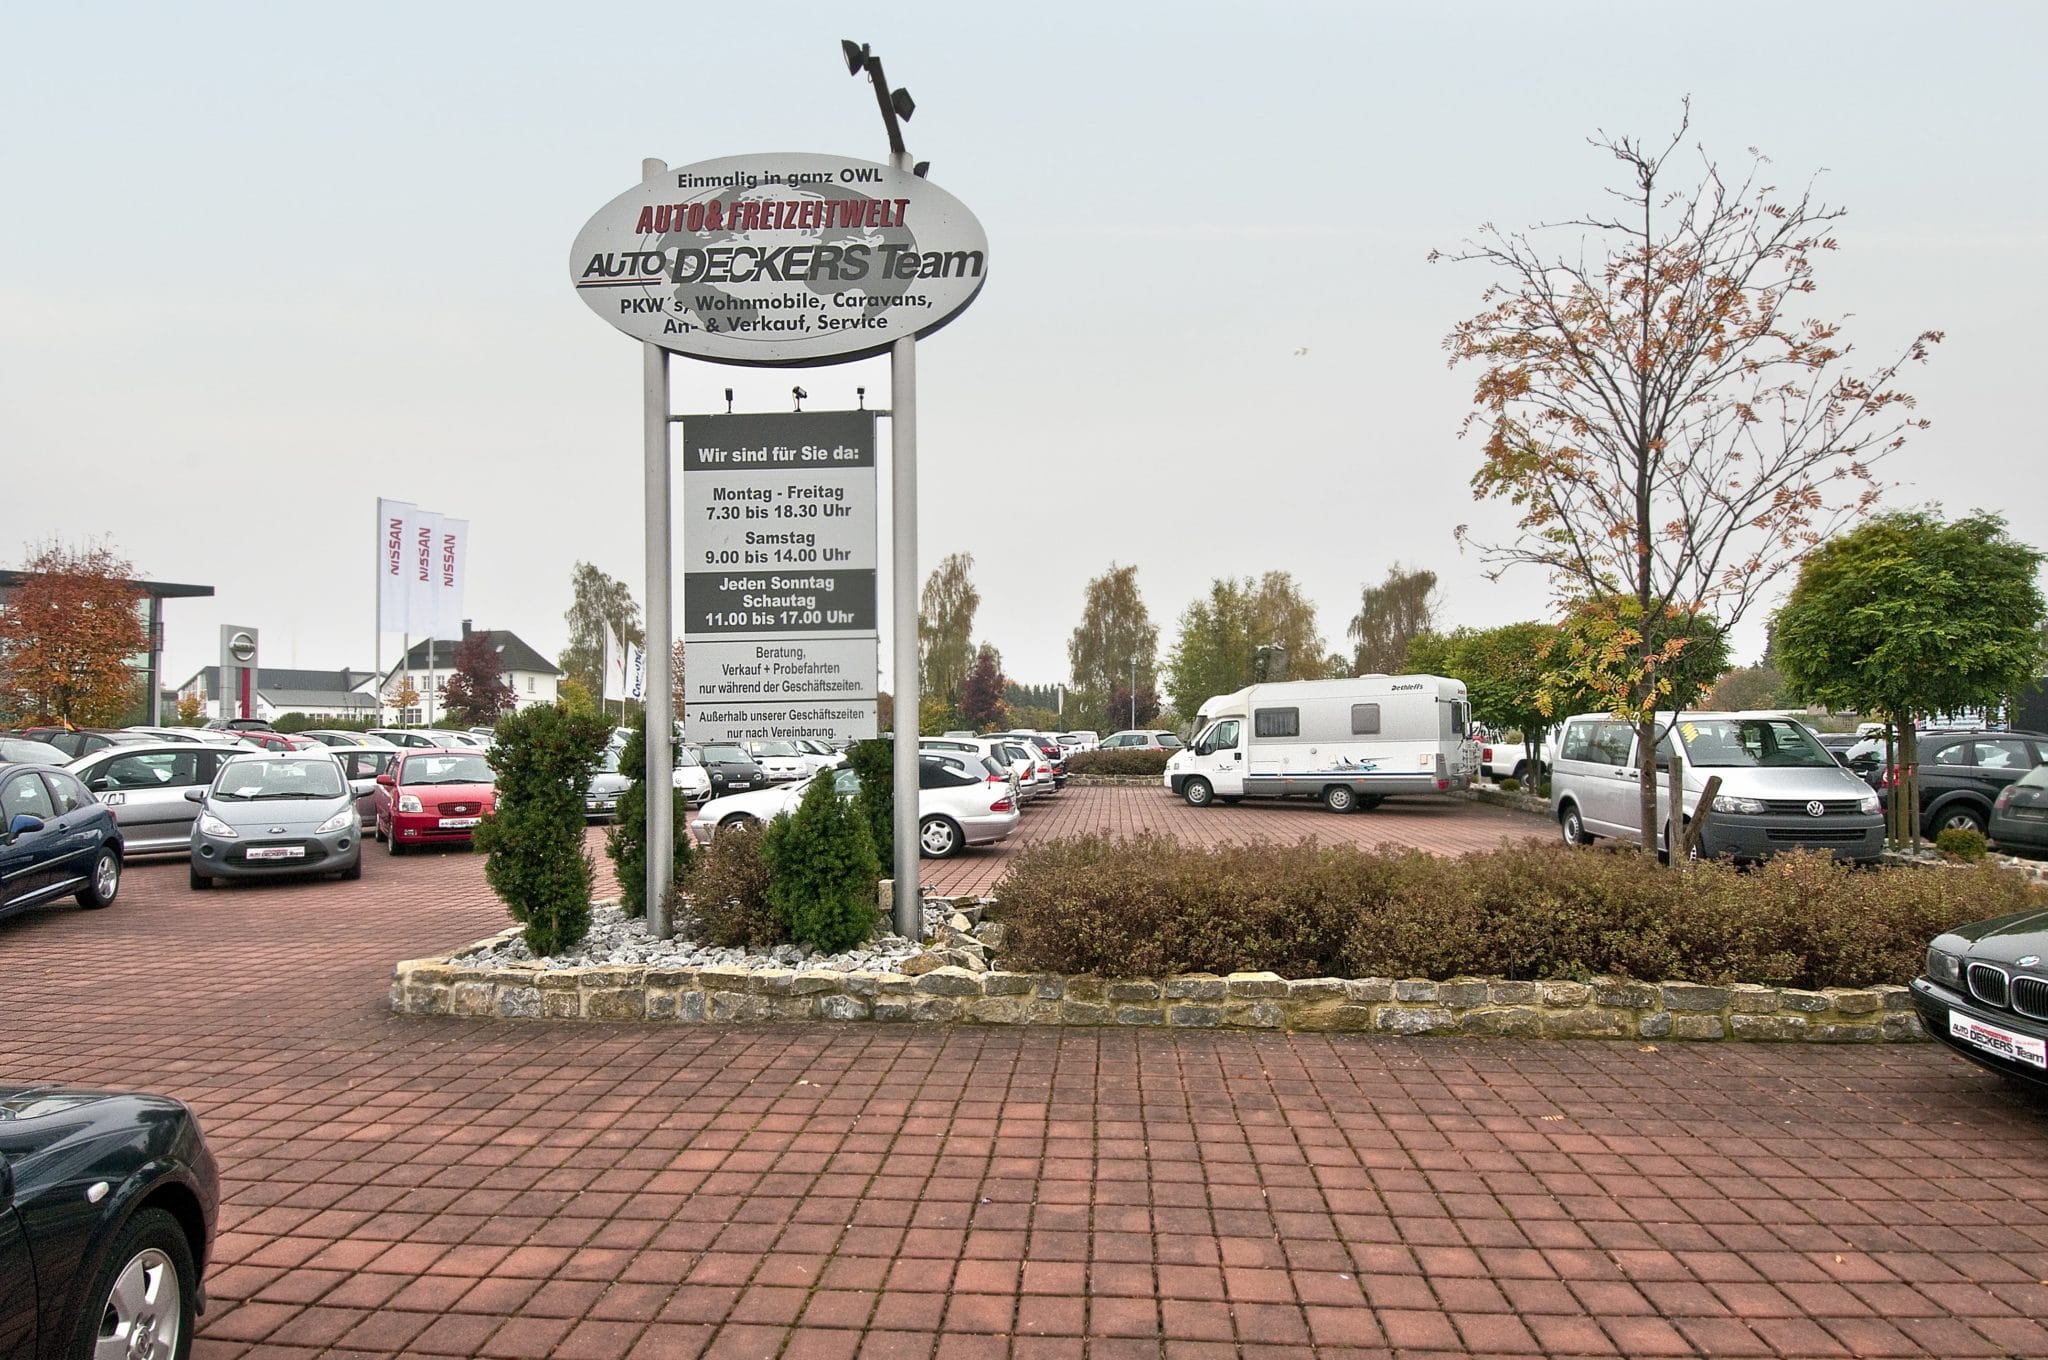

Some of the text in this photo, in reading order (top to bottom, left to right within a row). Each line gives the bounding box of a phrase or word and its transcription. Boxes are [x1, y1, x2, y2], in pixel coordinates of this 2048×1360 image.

[678, 169, 883, 190] Einmalig in ganz OWL
[583, 243, 984, 283] AUTO DECKERS Team
[695, 293, 826, 311] Wohnmobile,
[833, 292, 933, 309] Caravans,
[663, 315, 888, 334] An- & Verkauf, Service
[699, 446, 859, 463] Wir sind für Sie da:
[713, 487, 772, 502] Montag
[788, 486, 844, 501] Freitag
[706, 504, 851, 520] 7.30 bis 18.30 Uhr
[745, 531, 815, 546] Samstag
[389, 519, 402, 575] NISSAN
[418, 528, 431, 581] NISSAN
[443, 534, 455, 587] NISSAN
[705, 548, 851, 564] 9.00 bis 14.00 Uhr
[720, 576, 834, 591] Jeden Sonntag
[743, 594, 816, 608] Schautag
[705, 611, 854, 626] 11.00 bis 17.00 Uhr
[756, 646, 806, 660] Beratung,
[722, 663, 761, 676] Verkauf
[773, 662, 840, 675] Probefahrten
[700, 680, 863, 694] nur während der Geschäftszeiten.
[699, 708, 864, 722] Außerhalb unserer Geschäftszeiten
[727, 725, 836, 740] nur nach Vereinbarung.
[1953, 1024, 1968, 1034] AUTO
[1970, 1030, 2013, 1053] DECKERS
[2015, 1046, 2043, 1063] Team
